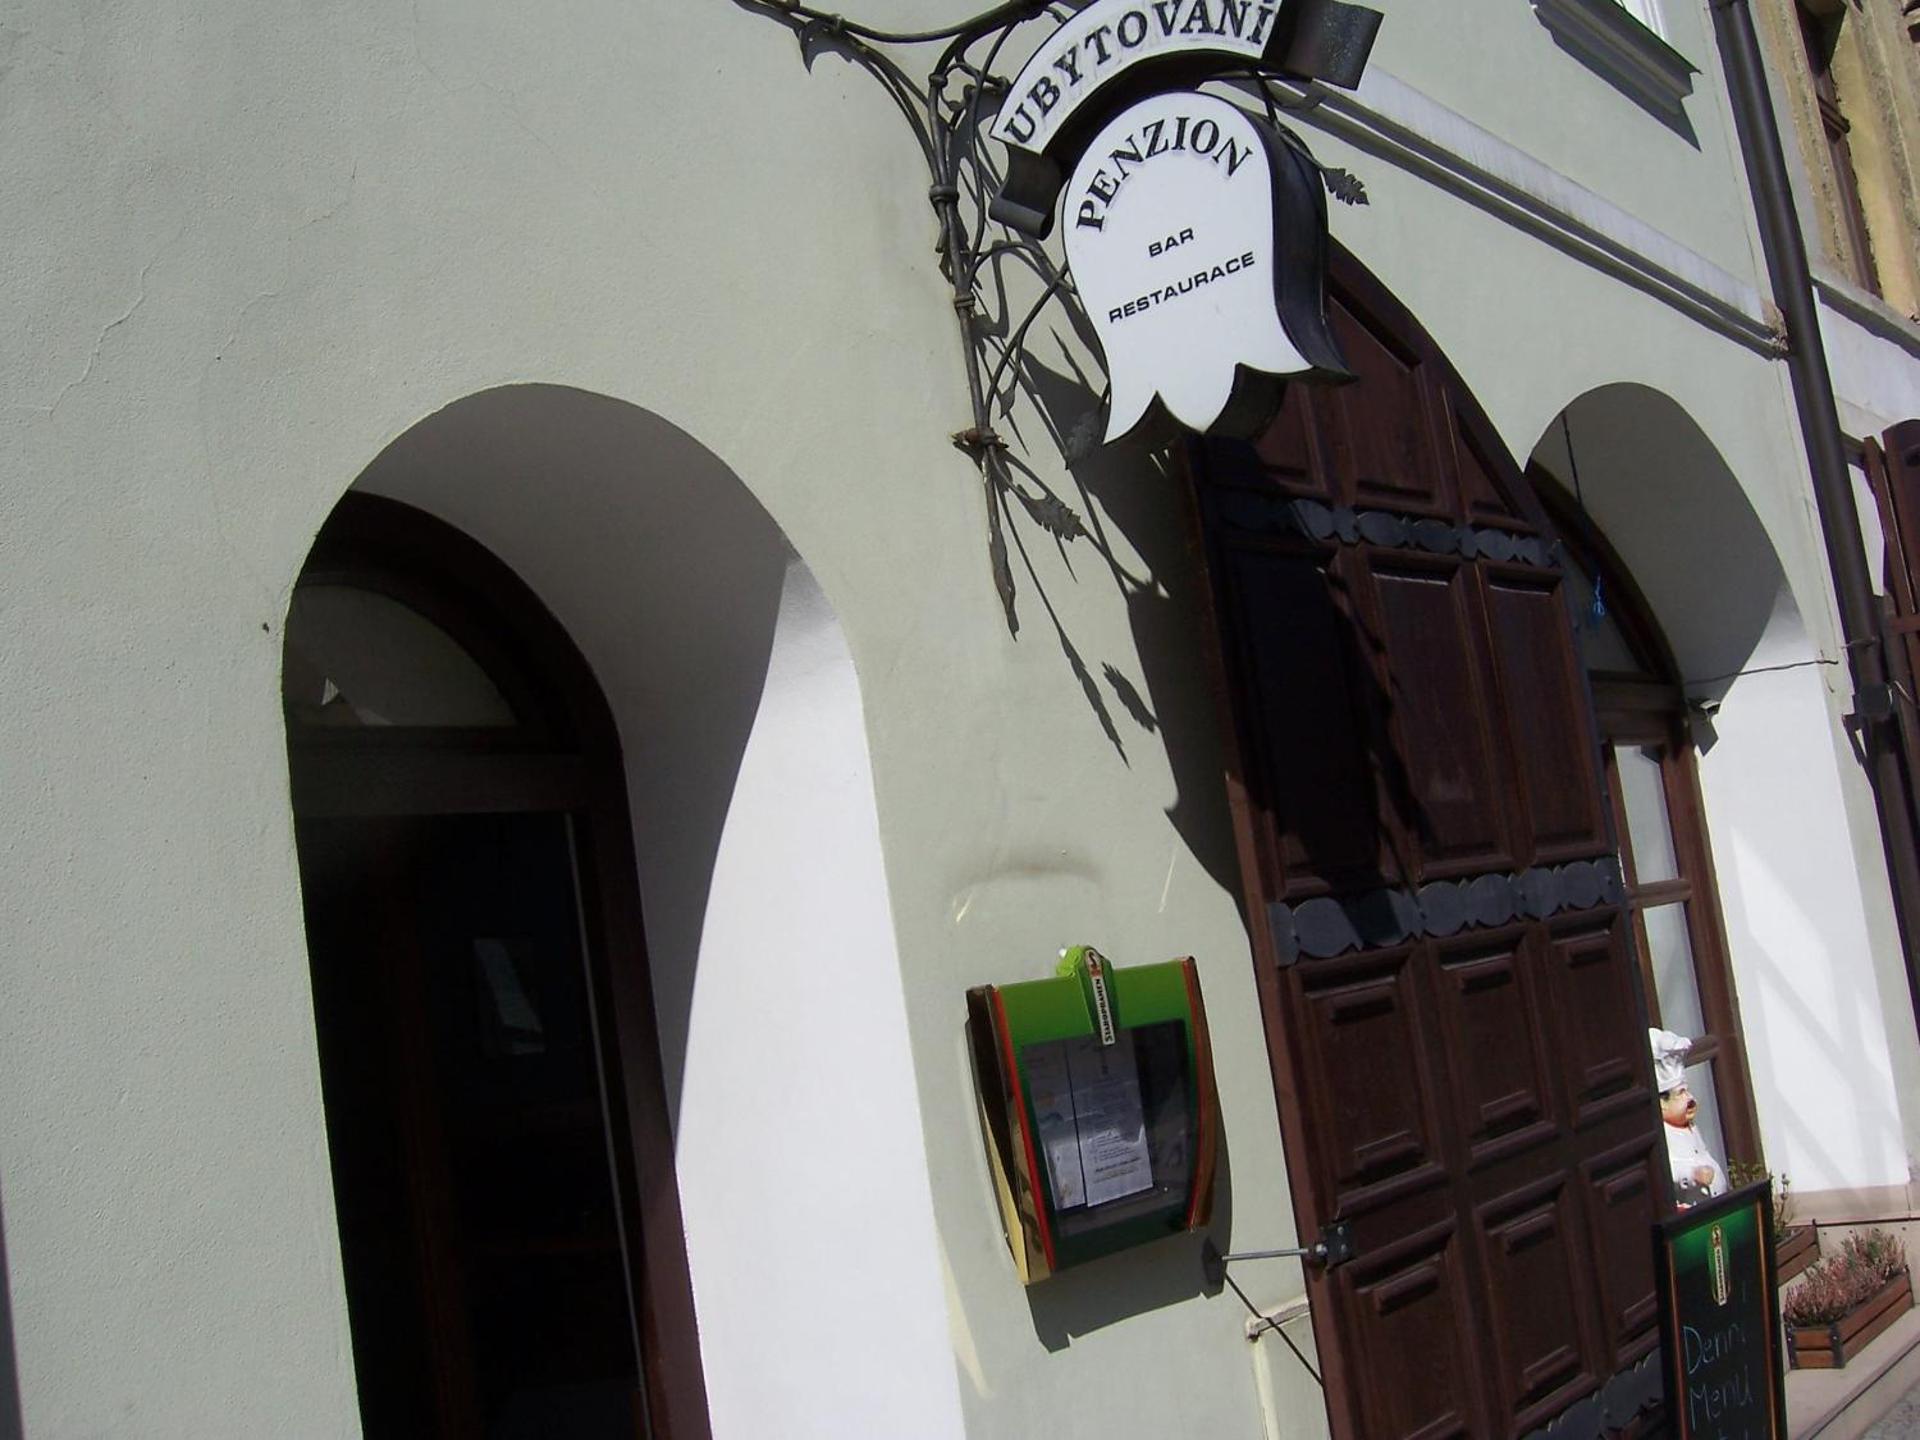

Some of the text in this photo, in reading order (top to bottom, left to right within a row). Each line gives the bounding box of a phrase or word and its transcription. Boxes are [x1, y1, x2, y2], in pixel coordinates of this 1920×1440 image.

[1076, 116, 1254, 233] PENZION
[1148, 227, 1195, 259] BAR
[1108, 251, 1255, 324] RESTAURACE
